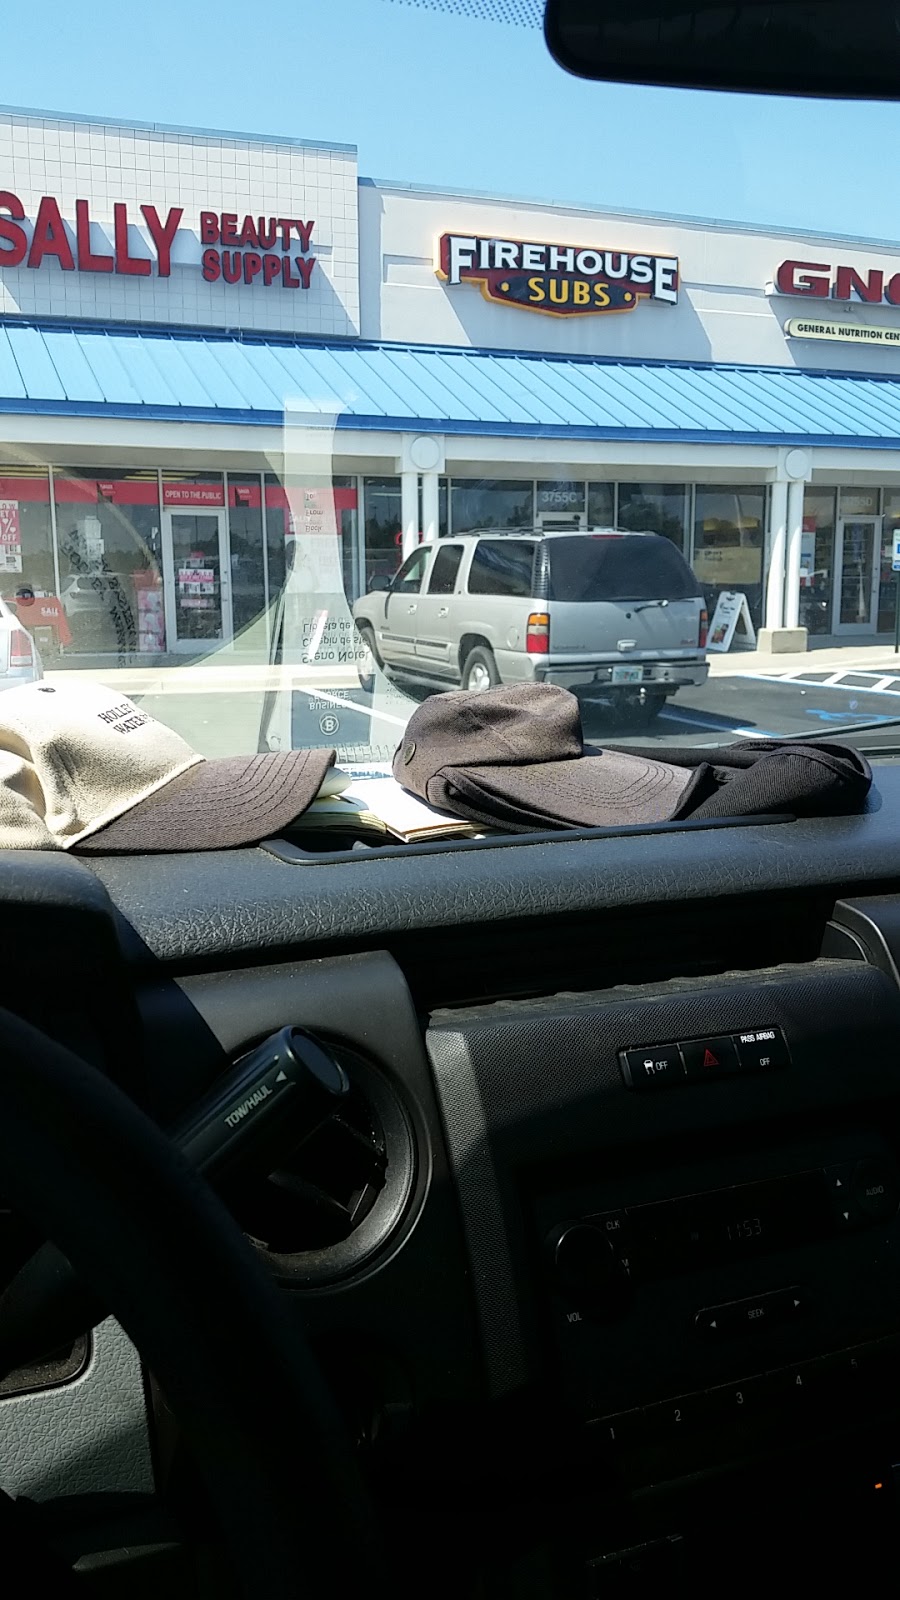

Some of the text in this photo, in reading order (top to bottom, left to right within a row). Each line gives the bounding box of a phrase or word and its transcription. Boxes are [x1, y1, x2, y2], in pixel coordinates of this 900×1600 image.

[0, 190, 184, 277] SALLY
[200, 211, 315, 253] BEAUTY
[201, 249, 317, 289] SUPPLY
[448, 235, 679, 305] FIREHOUSE
[527, 277, 612, 307] SUBS
[797, 323, 900, 341] GENERAL NUTRITION CEN
[165, 490, 222, 500] OPEN TO THE PUBLIC
[541, 490, 577, 505] 3755C
[2, 533, 17, 541] OFF
[98, 703, 135, 723] HOLLEY
[740, 1031, 776, 1043] PASS AIRBAG
[655, 1061, 668, 1070] OFF
[759, 1057, 770, 1066] OFF
[224, 1085, 273, 1127] TOW/HAUL
[865, 1184, 884, 1197] AUDIO
[605, 1219, 621, 1231] CLK
[566, 1312, 582, 1323] VOL
[747, 1308, 765, 1320] SEEK
[795, 1374, 802, 1386] 4
[735, 1392, 744, 1404] 3
[674, 1409, 681, 1422] 2
[609, 1427, 615, 1440] 1
